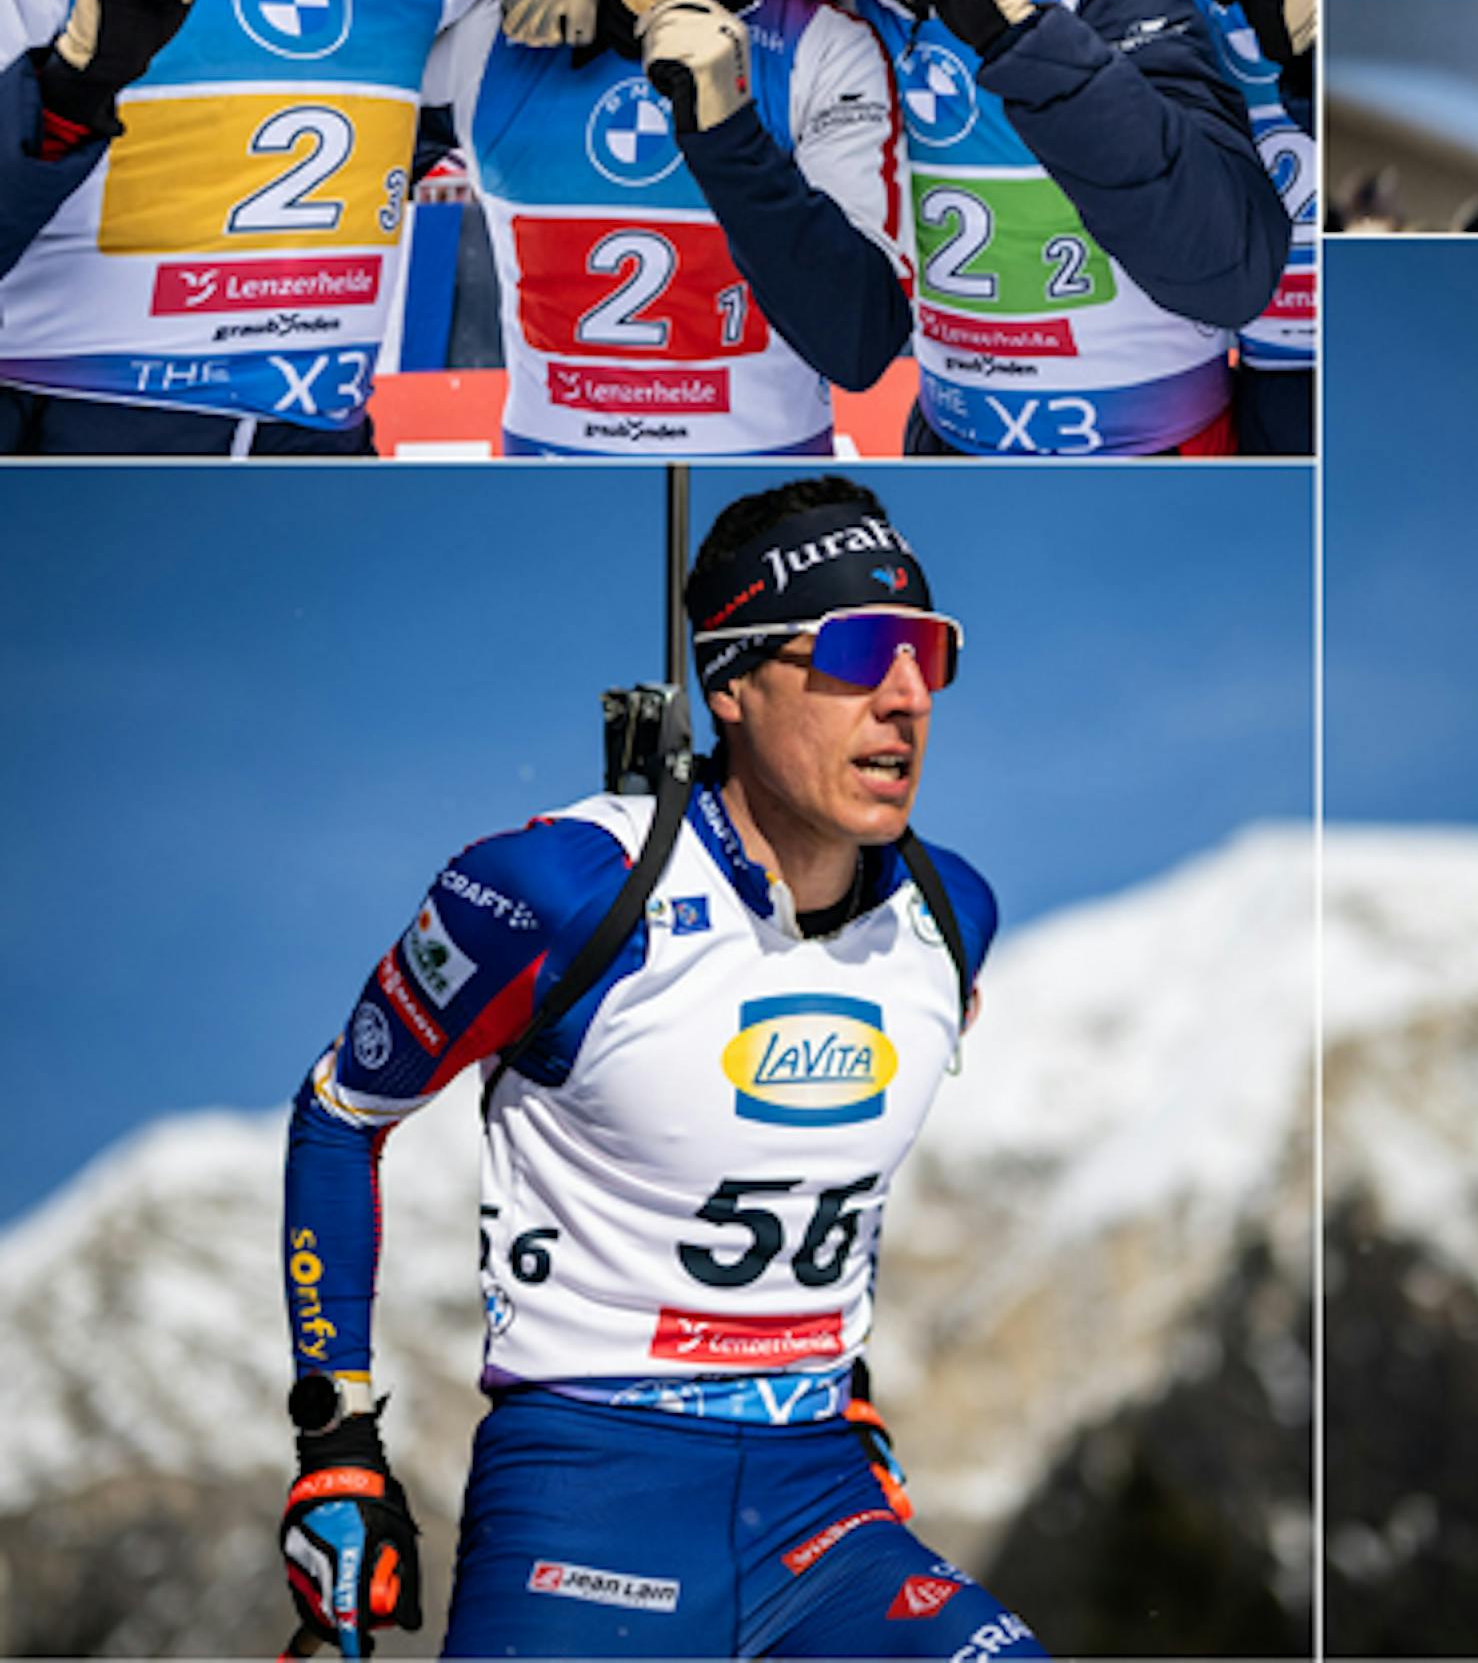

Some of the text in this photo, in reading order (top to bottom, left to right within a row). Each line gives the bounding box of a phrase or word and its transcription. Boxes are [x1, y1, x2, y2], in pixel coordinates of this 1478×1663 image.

[224, 104, 357, 236] 2
[918, 185, 997, 302] 2
[1044, 235, 1093, 302] 2
[225, 269, 374, 301] Lenzerheide
[573, 225, 679, 351] 2
[715, 278, 750, 347] 1
[266, 350, 370, 420] X3
[584, 379, 717, 405] Lenzerheide
[984, 394, 1104, 456] X3
[440, 869, 513, 920] CRAFT
[674, 1172, 882, 1290] 56
[290, 1227, 337, 1362] somfy
[564, 1571, 676, 1602] Jean Lain
